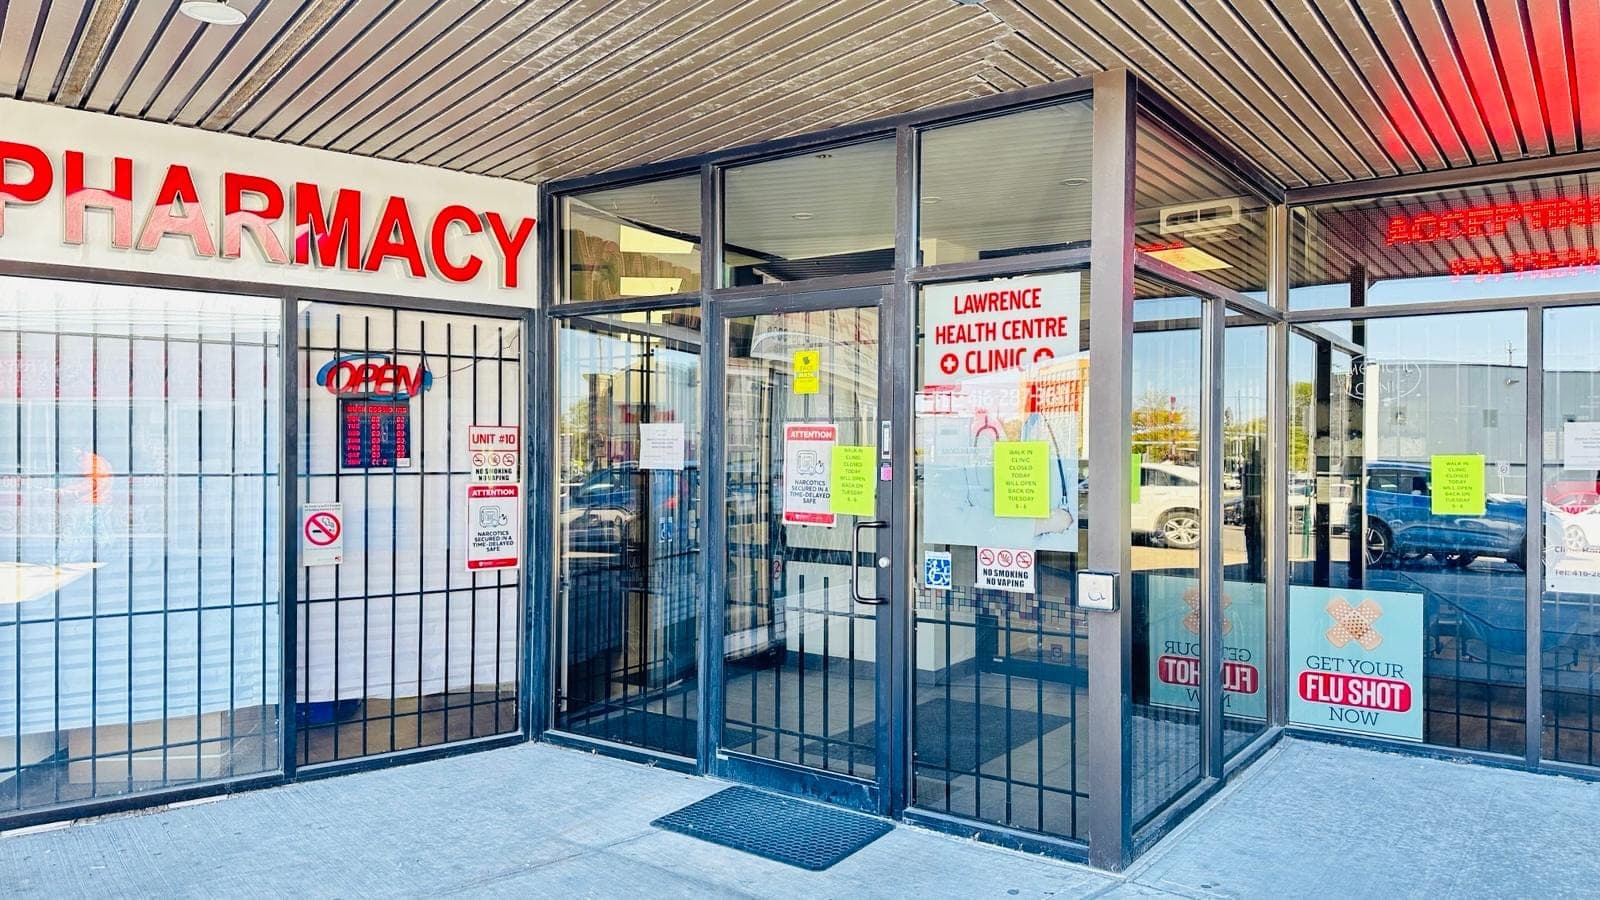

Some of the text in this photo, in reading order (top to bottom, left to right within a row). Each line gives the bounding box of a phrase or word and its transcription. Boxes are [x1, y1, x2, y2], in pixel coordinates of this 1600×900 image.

[0, 141, 536, 288] PHARMACY
[954, 288, 1042, 315] LAWRENCE
[935, 316, 1068, 345] HEALTH CENTRE
[965, 347, 1026, 374] CLINIC
[326, 361, 422, 397] OPEN
[472, 434, 516, 444] UNIT #10
[790, 430, 832, 439] ATTENTION
[472, 489, 514, 497] ATTENTION
[790, 491, 831, 499] TIME-DELAYED
[983, 568, 1028, 579] NO SMOKING
[997, 578, 1024, 587] VAPING
[1306, 656, 1404, 678] GET YOUR
[1306, 674, 1404, 710] FLU SHOT
[1329, 706, 1380, 726] NOW
